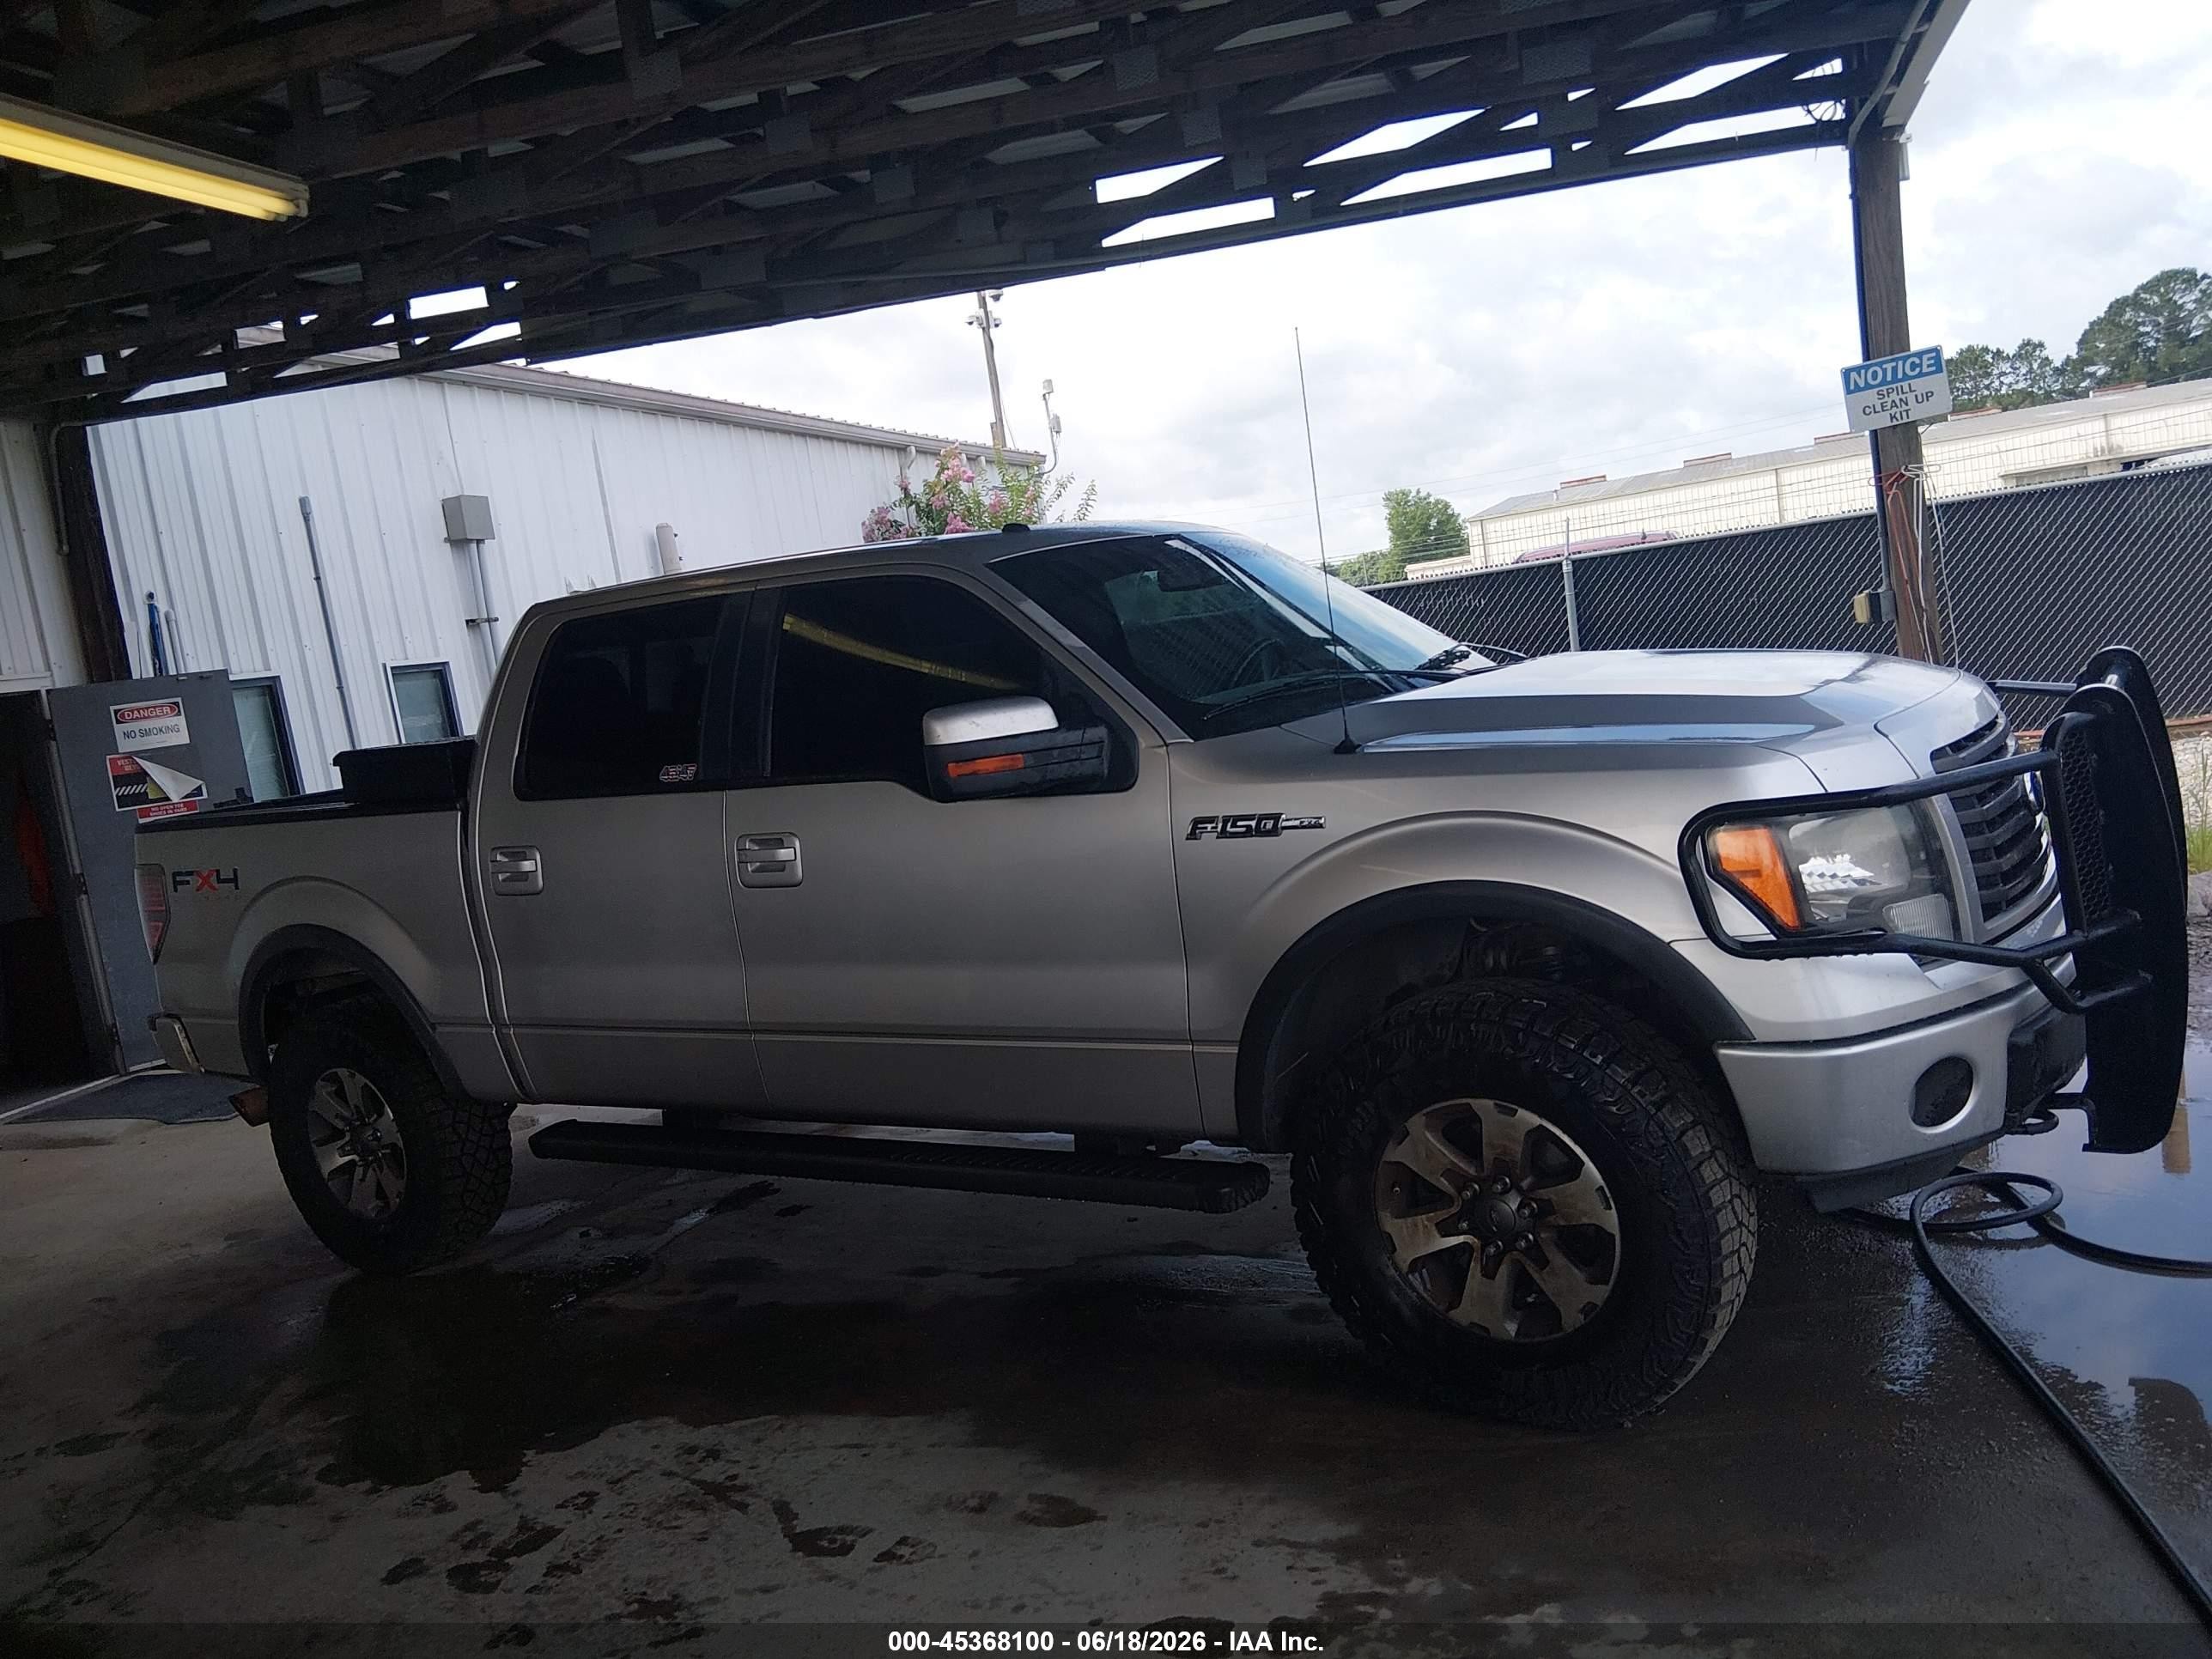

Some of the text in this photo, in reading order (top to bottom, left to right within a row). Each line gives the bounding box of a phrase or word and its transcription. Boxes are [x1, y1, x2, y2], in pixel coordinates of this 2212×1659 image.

[1849, 352, 1936, 391] NOTICE
[1876, 382, 1917, 401] SPILL
[1862, 390, 1935, 416] CLEAN UP
[1889, 408, 1911, 424] KIT
[124, 705, 172, 720] DANGER
[123, 723, 181, 741] NO SMOKING
[172, 866, 240, 893] FX4
